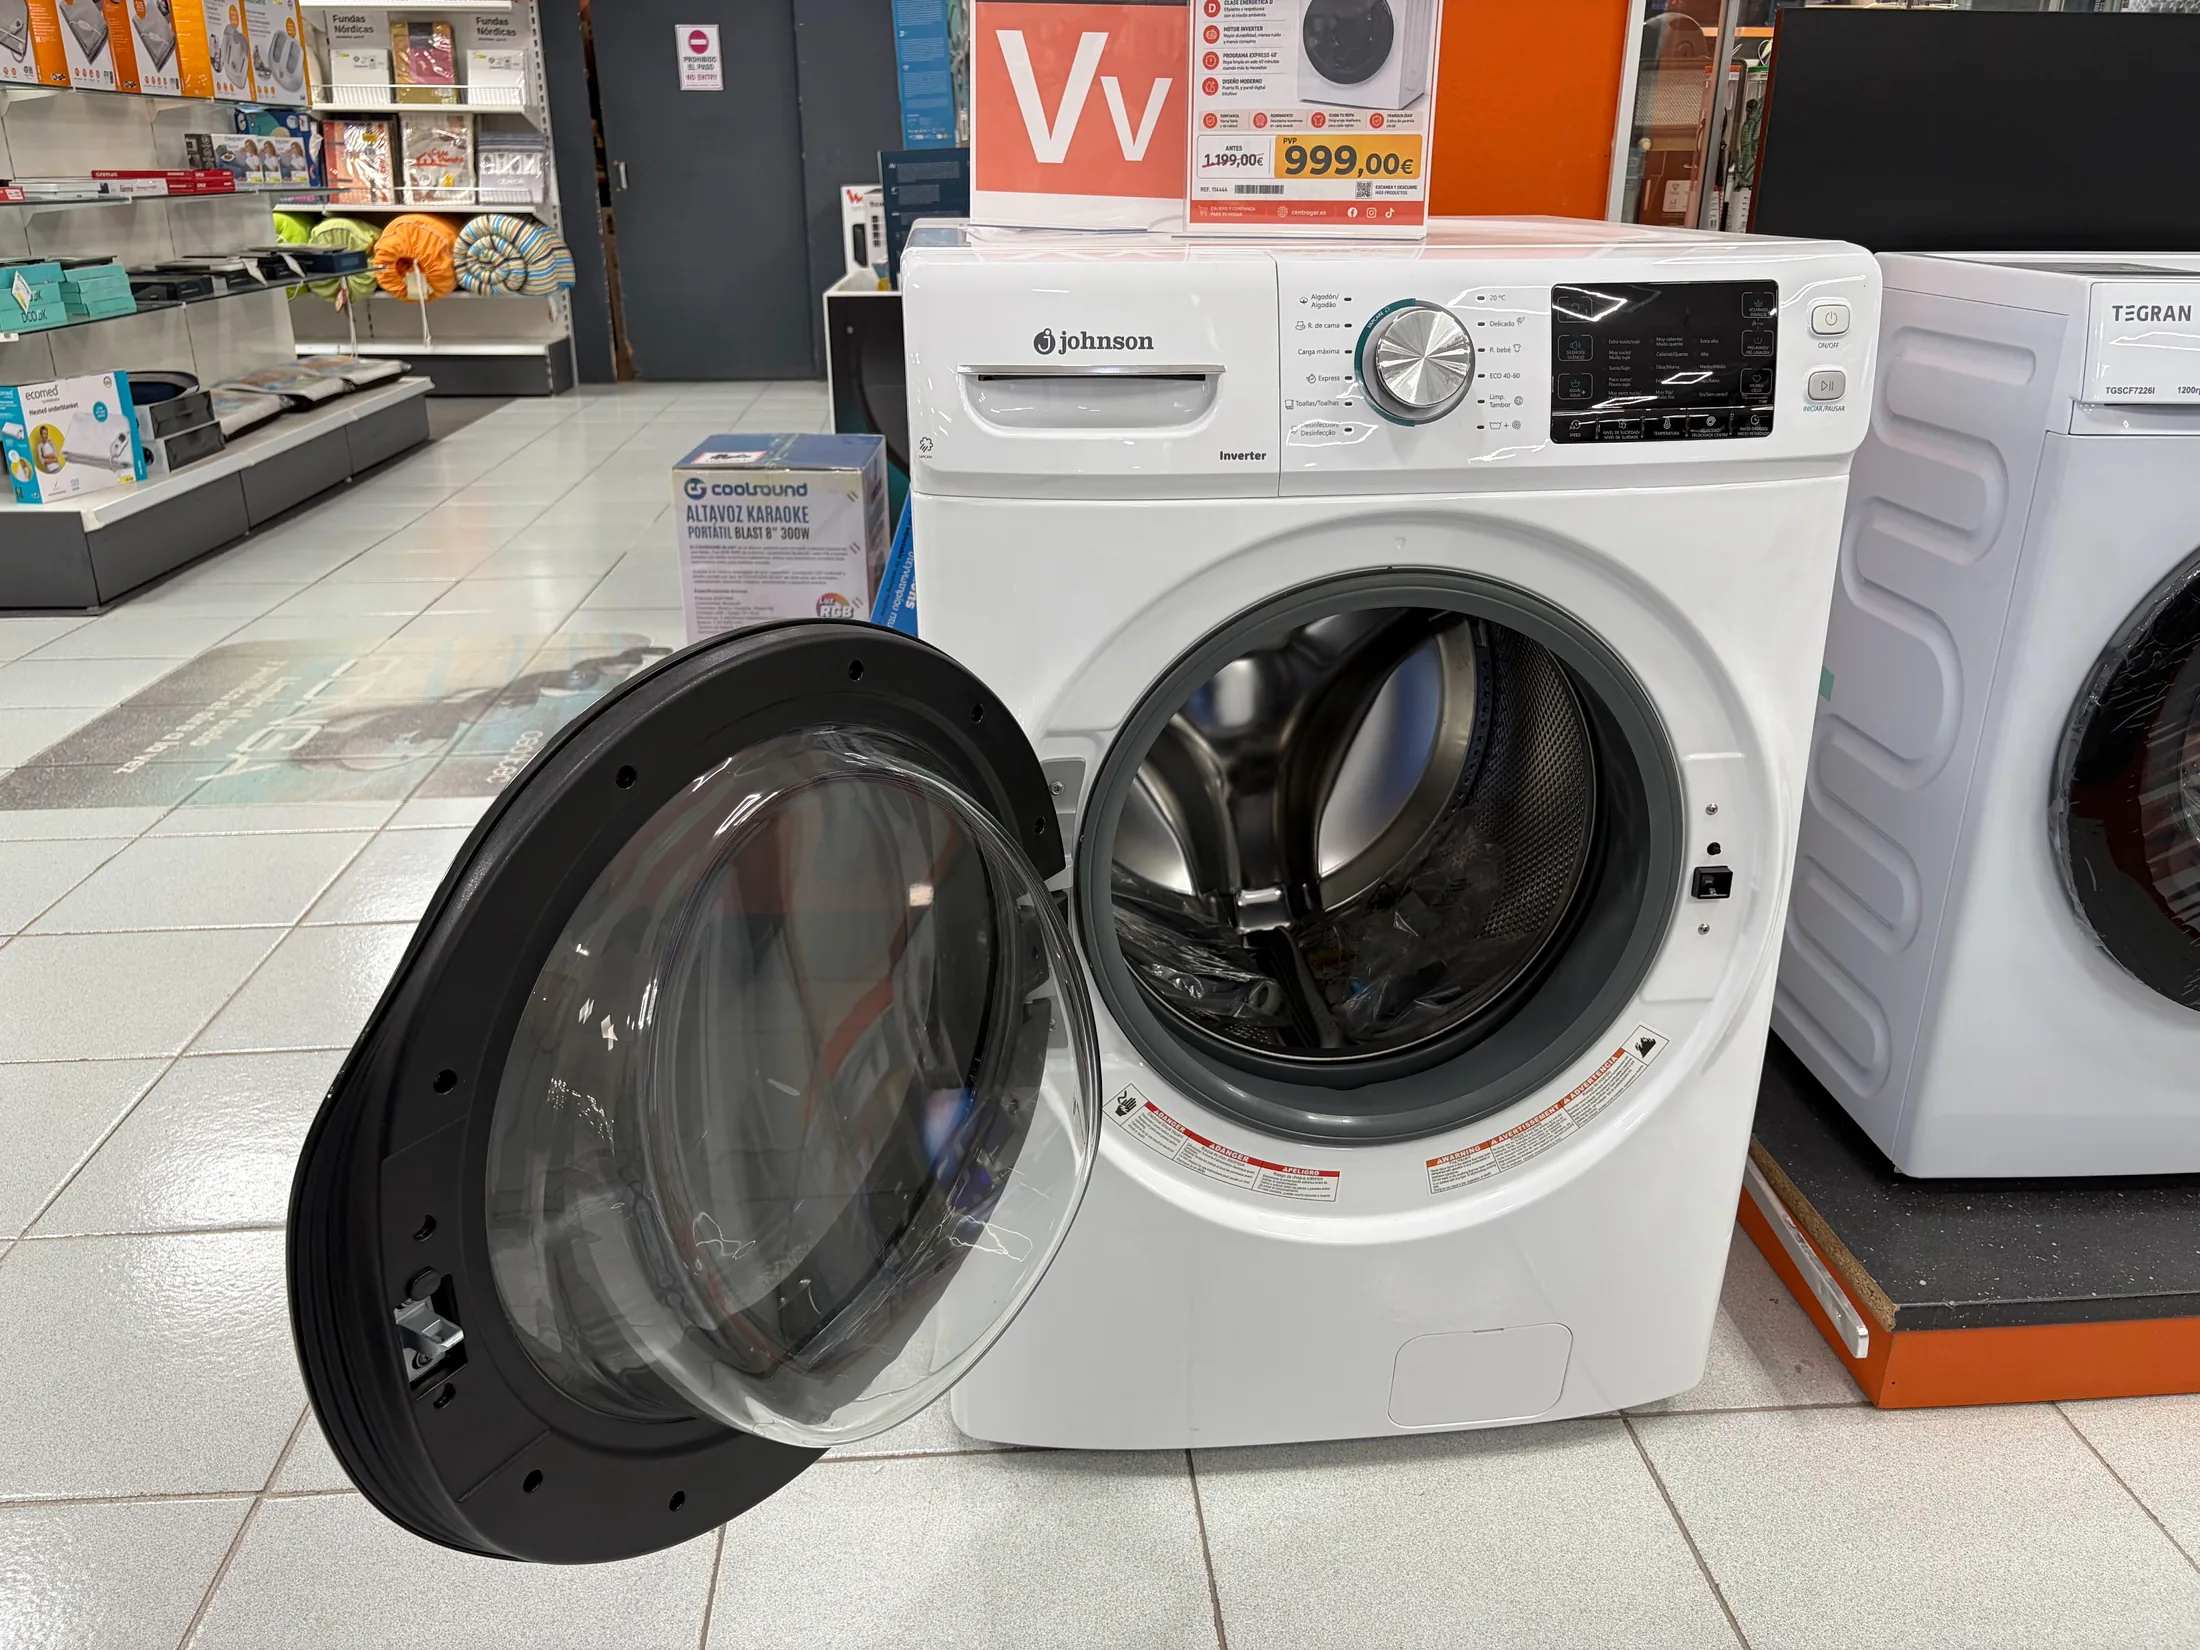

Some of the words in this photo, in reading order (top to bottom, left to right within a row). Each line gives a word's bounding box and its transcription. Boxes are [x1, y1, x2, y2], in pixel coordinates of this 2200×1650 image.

[332, 15, 366, 24] Fundas
[476, 17, 509, 26] Fundas
[334, 25, 374, 34] Nórdicas
[477, 27, 517, 37] Nórdicas
[1204, 154, 1263, 167] 1.199,00€
[1285, 145, 1413, 178] 999,00€
[2112, 305, 2192, 321] TEGRAN
[1058, 331, 1154, 355] johnson
[1318, 375, 1340, 383] Express
[25, 385, 59, 400] ecomed
[29, 405, 47, 416] Heated
[48, 402, 79, 413] underblanket
[1220, 451, 1267, 460] Inverter
[712, 482, 808, 497] coolsound
[686, 505, 743, 523] ALTAVOZ
[746, 505, 809, 523] KARAOKE
[688, 523, 733, 540] PORTÁTIL
[735, 526, 763, 540] BLAST
[781, 527, 810, 540] 300W
[820, 606, 854, 618] RGB
[1570, 1056, 1618, 1099] ADVERTENCIA
[1498, 1104, 1560, 1142] AVERTISSEMENT
